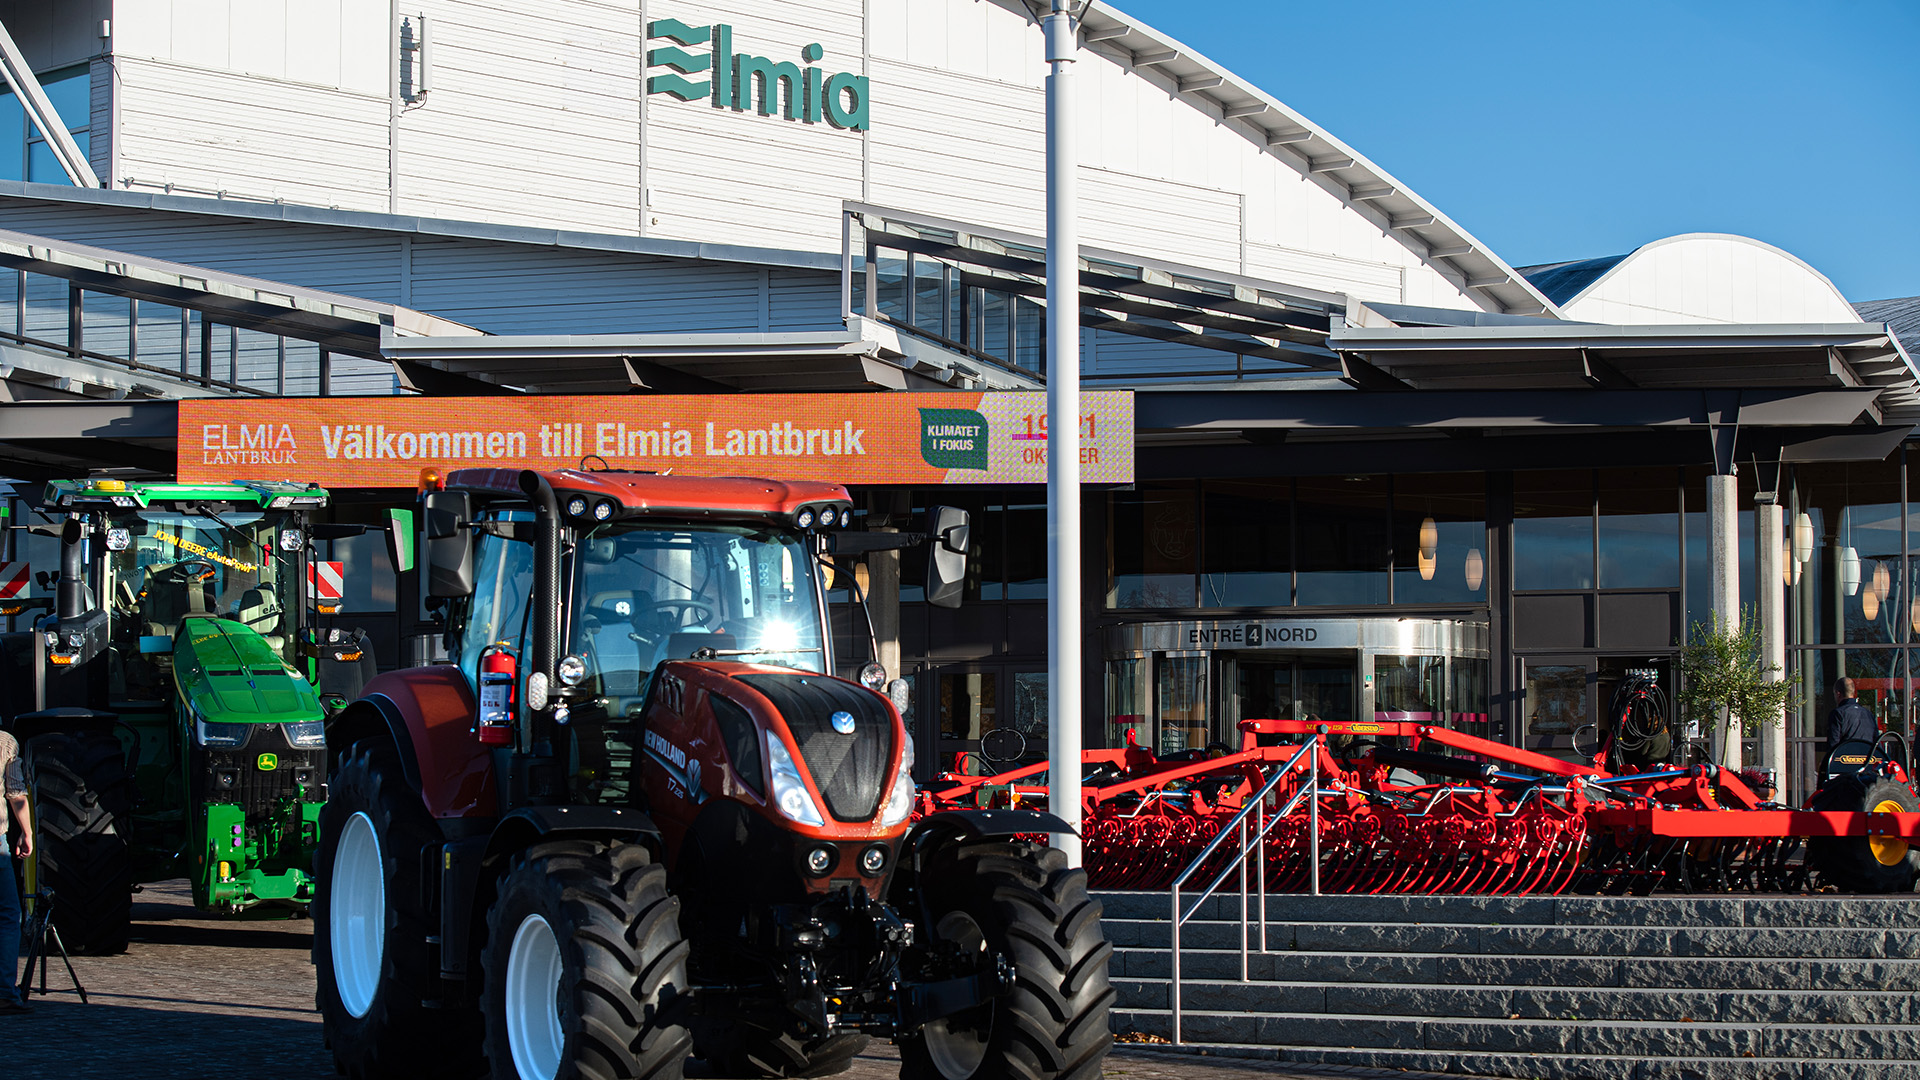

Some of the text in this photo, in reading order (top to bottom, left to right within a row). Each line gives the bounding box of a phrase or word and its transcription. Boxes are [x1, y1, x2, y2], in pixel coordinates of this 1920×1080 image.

[203, 423, 297, 450] ELMIA
[321, 421, 866, 459] Välkommen till Elmia Lantbruk
[928, 425, 980, 438] KLIMATET
[940, 438, 974, 451] FOKUS
[203, 450, 297, 465] LANTBRUK
[1023, 448, 1099, 464] OKER
[153, 529, 179, 546] JOHN
[178, 538, 207, 557] DEERE
[1189, 624, 1318, 643] ENTRÉ 4 NORD
[644, 728, 686, 769] NEW HOLLAND
[667, 776, 677, 791] T7
